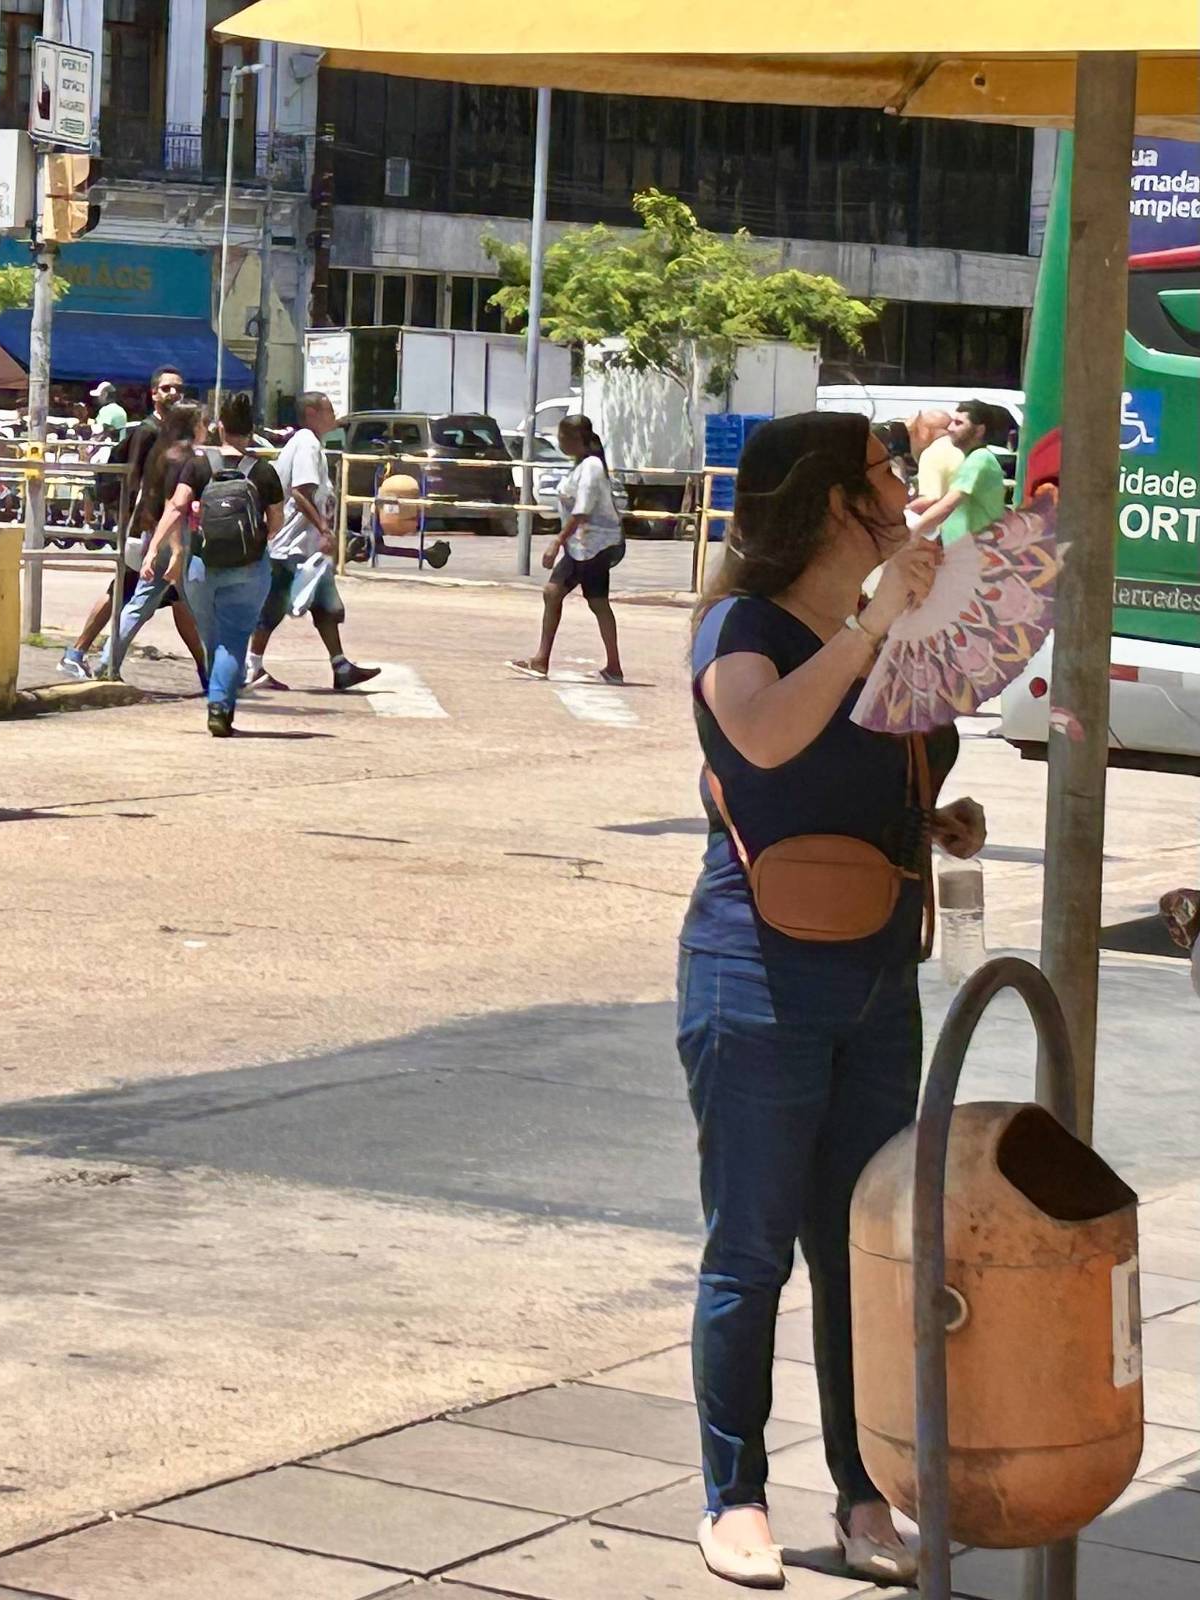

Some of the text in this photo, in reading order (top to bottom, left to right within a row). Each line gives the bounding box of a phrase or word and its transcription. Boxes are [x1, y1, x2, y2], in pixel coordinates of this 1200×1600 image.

[1131, 149, 1158, 167] ua
[1118, 466, 1197, 499] idade
[1118, 503, 1200, 544] ORT
[1112, 580, 1200, 611] ercedes
